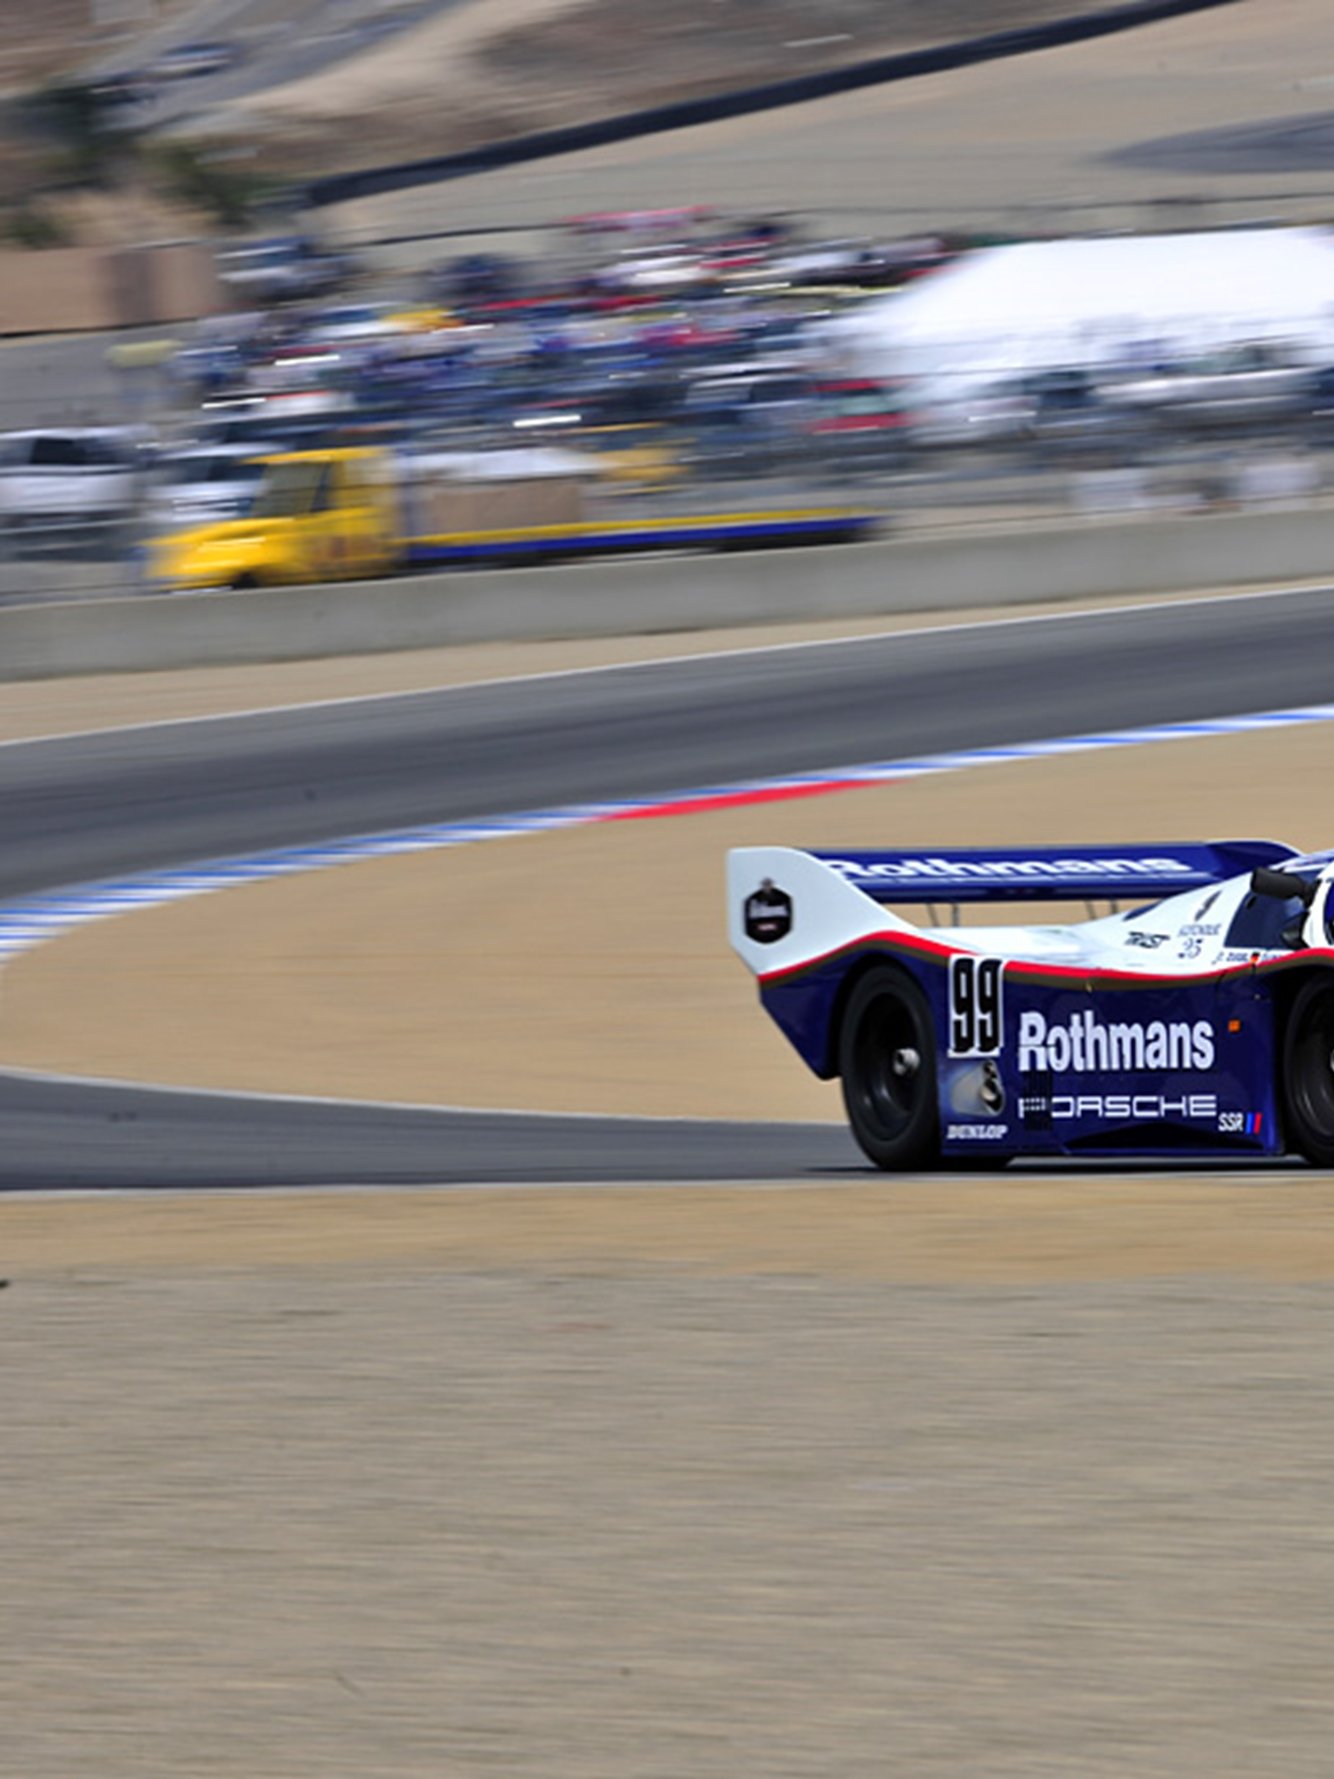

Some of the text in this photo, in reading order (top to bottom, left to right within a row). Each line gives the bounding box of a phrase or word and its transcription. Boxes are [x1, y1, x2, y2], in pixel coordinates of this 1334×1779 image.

[822, 857, 1194, 878] Rothmans
[951, 957, 1003, 1054] 99
[1017, 1010, 1215, 1072] Rothmans
[946, 1124, 1008, 1140] DUNLOP
[1218, 1112, 1244, 1132] SSR
